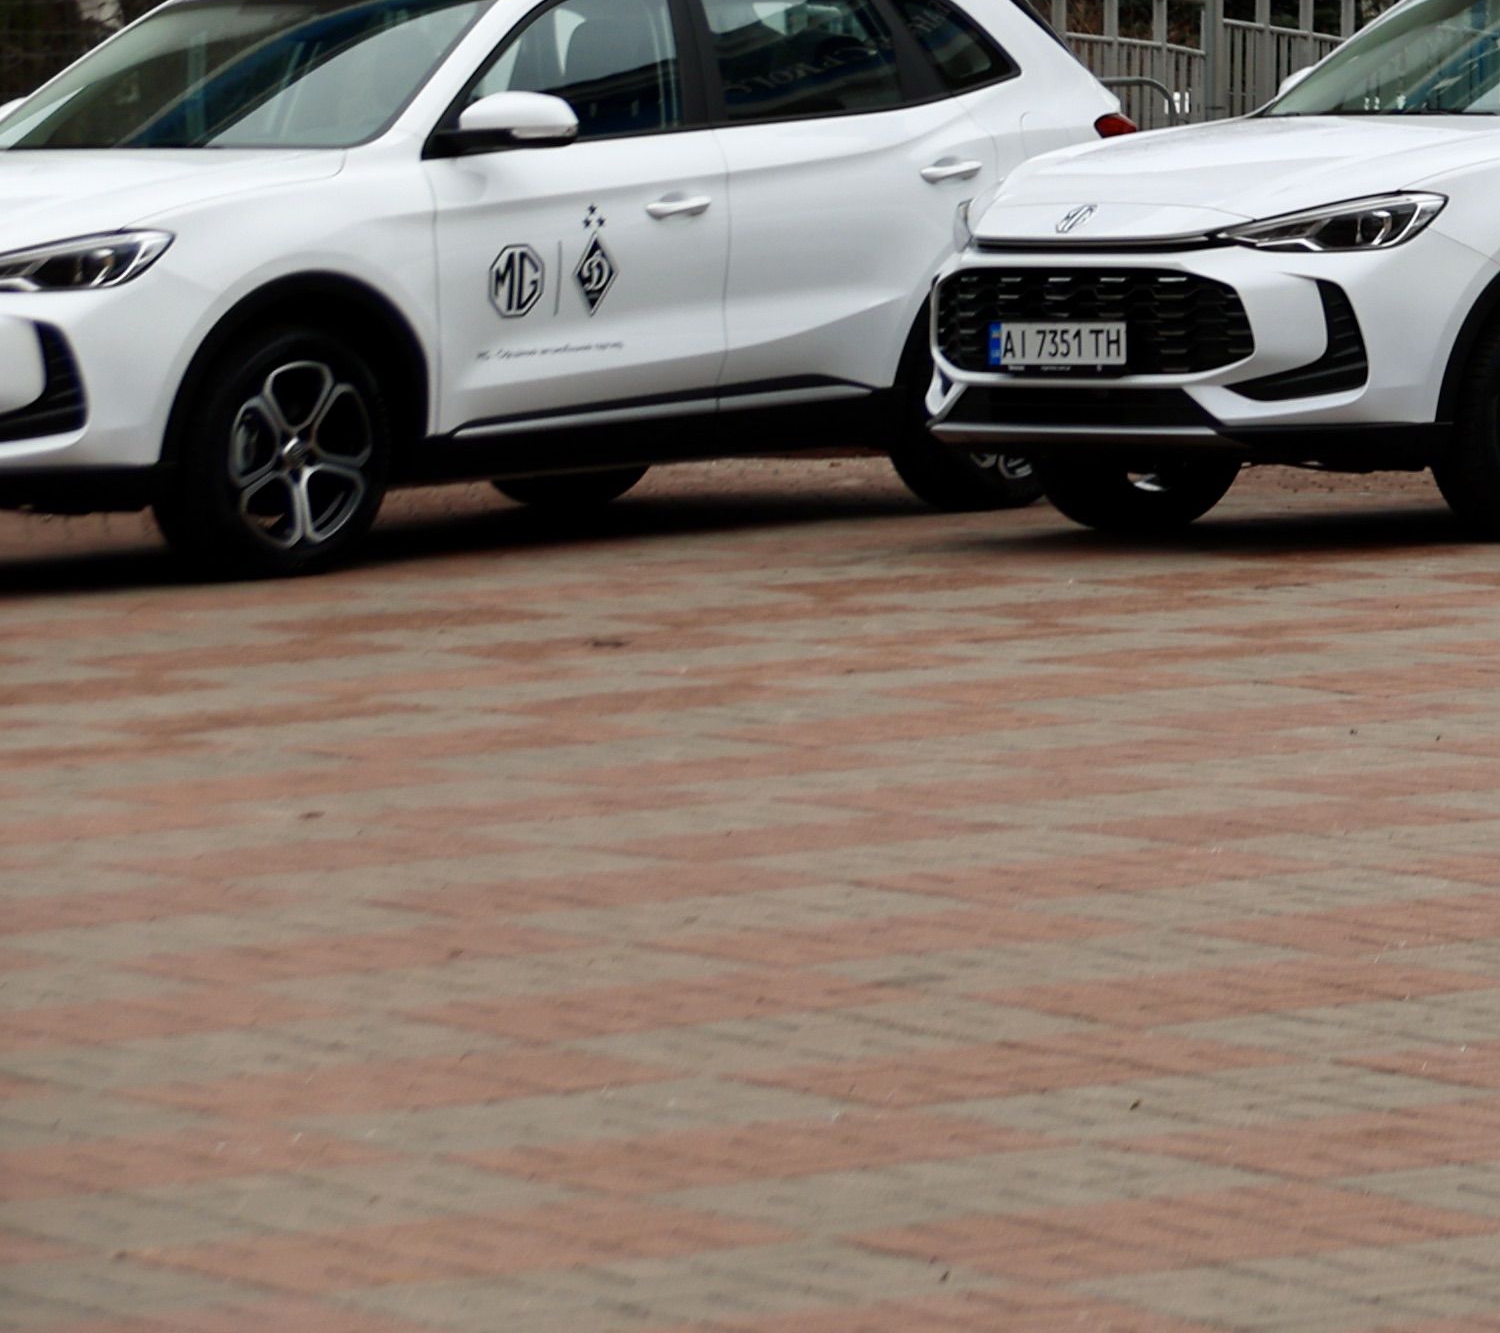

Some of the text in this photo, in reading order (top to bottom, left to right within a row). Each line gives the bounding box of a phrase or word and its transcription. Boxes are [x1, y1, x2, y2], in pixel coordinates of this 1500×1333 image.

[494, 251, 539, 311] MG
[1003, 329, 1121, 358] AI 7351 TH
